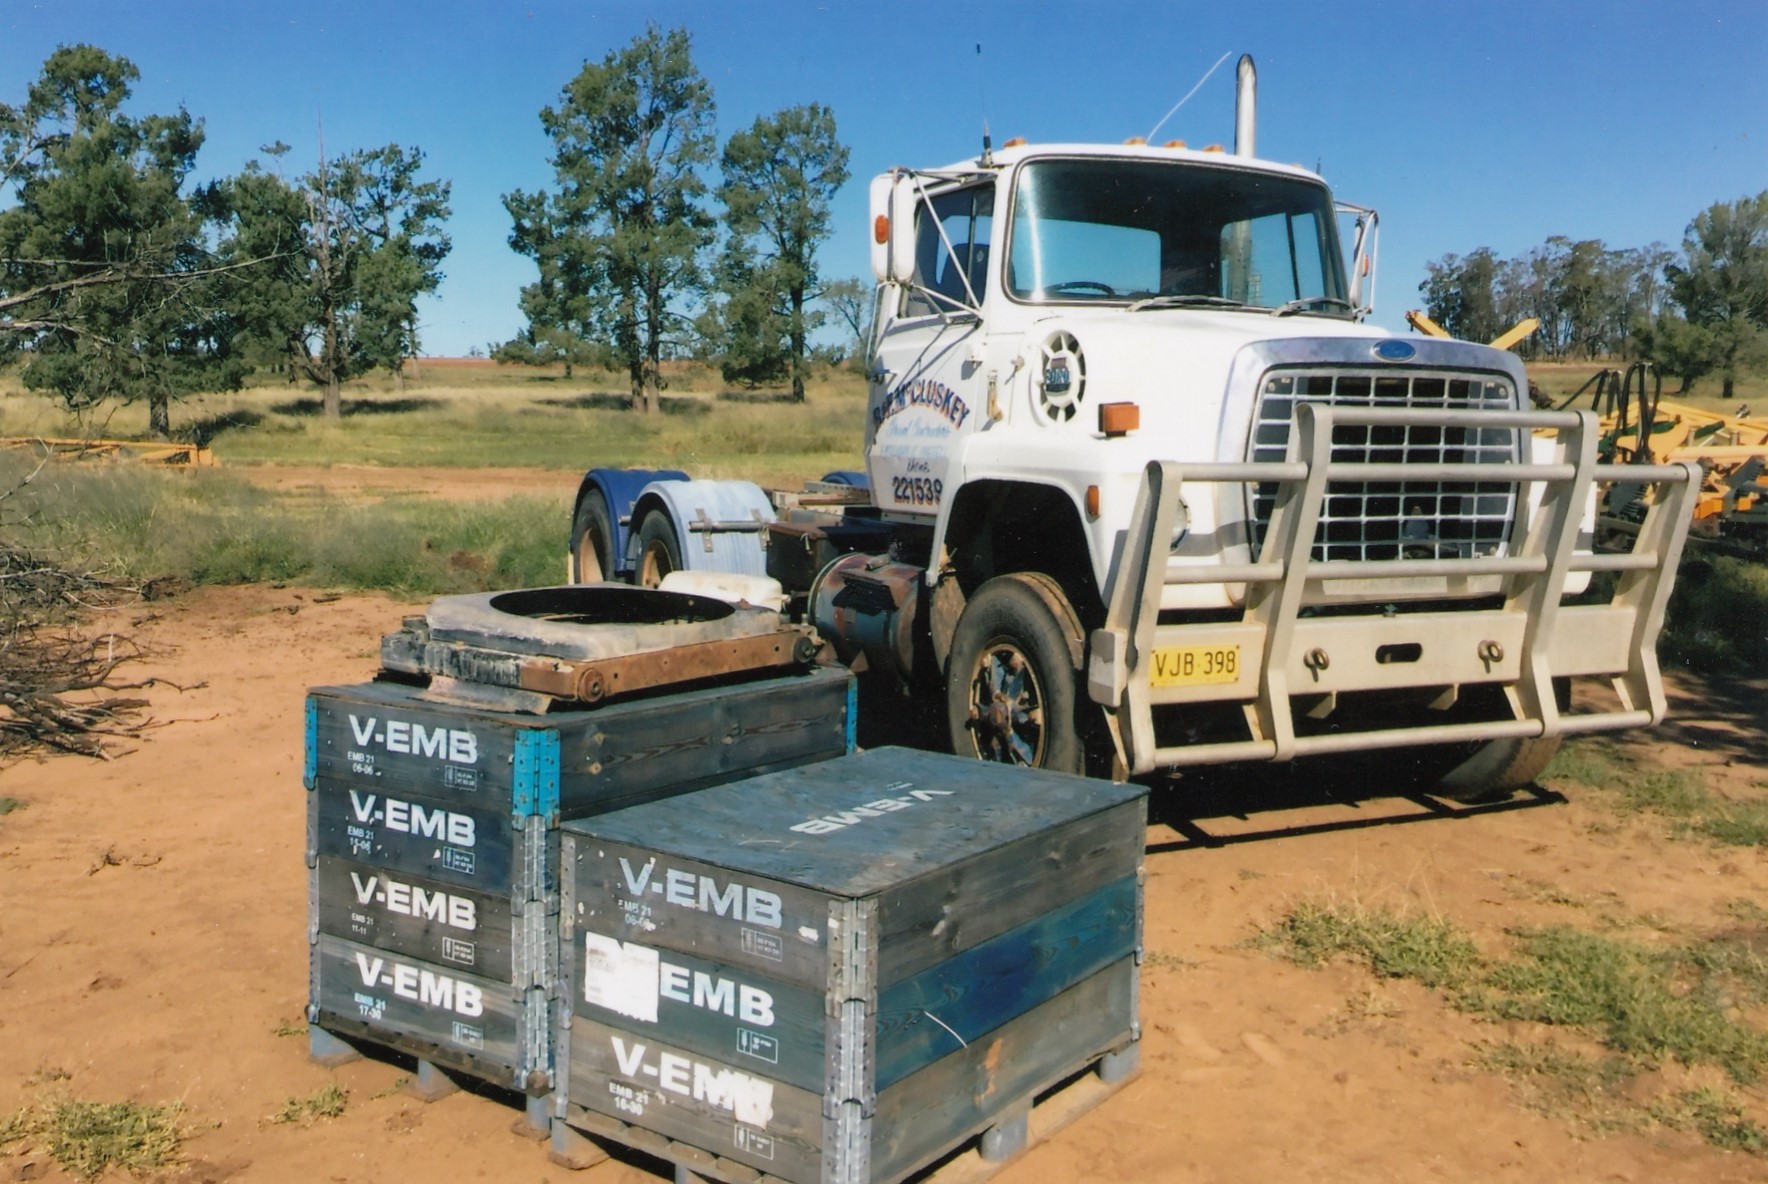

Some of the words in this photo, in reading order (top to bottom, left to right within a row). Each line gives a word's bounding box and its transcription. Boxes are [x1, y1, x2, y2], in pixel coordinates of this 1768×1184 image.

[892, 476, 943, 505] 221539
[1155, 652, 1194, 677] VJB
[1203, 650, 1236, 675] 398
[348, 714, 478, 764] V-EMB
[347, 750, 367, 763] EMB
[365, 752, 375, 764] 21
[349, 789, 477, 848] V-EMB
[789, 789, 955, 835] V-EMB
[347, 825, 366, 839] EMB
[364, 828, 375, 840] 21
[350, 871, 477, 931] V-EMB
[618, 856, 783, 929] V-EMB
[350, 912, 366, 924] EMB
[366, 915, 375, 926] 21
[618, 899, 640, 915] EMB
[640, 903, 652, 917] 21
[351, 924, 368, 936] 11-11
[355, 951, 483, 1018] V-EMB
[659, 961, 775, 1027] EMB
[354, 992, 374, 1007] EMB
[375, 996, 387, 1012] 21
[610, 1035, 773, 1120] V-EM
[608, 1081, 634, 1101] EMB
[635, 1090, 650, 1106] 21
